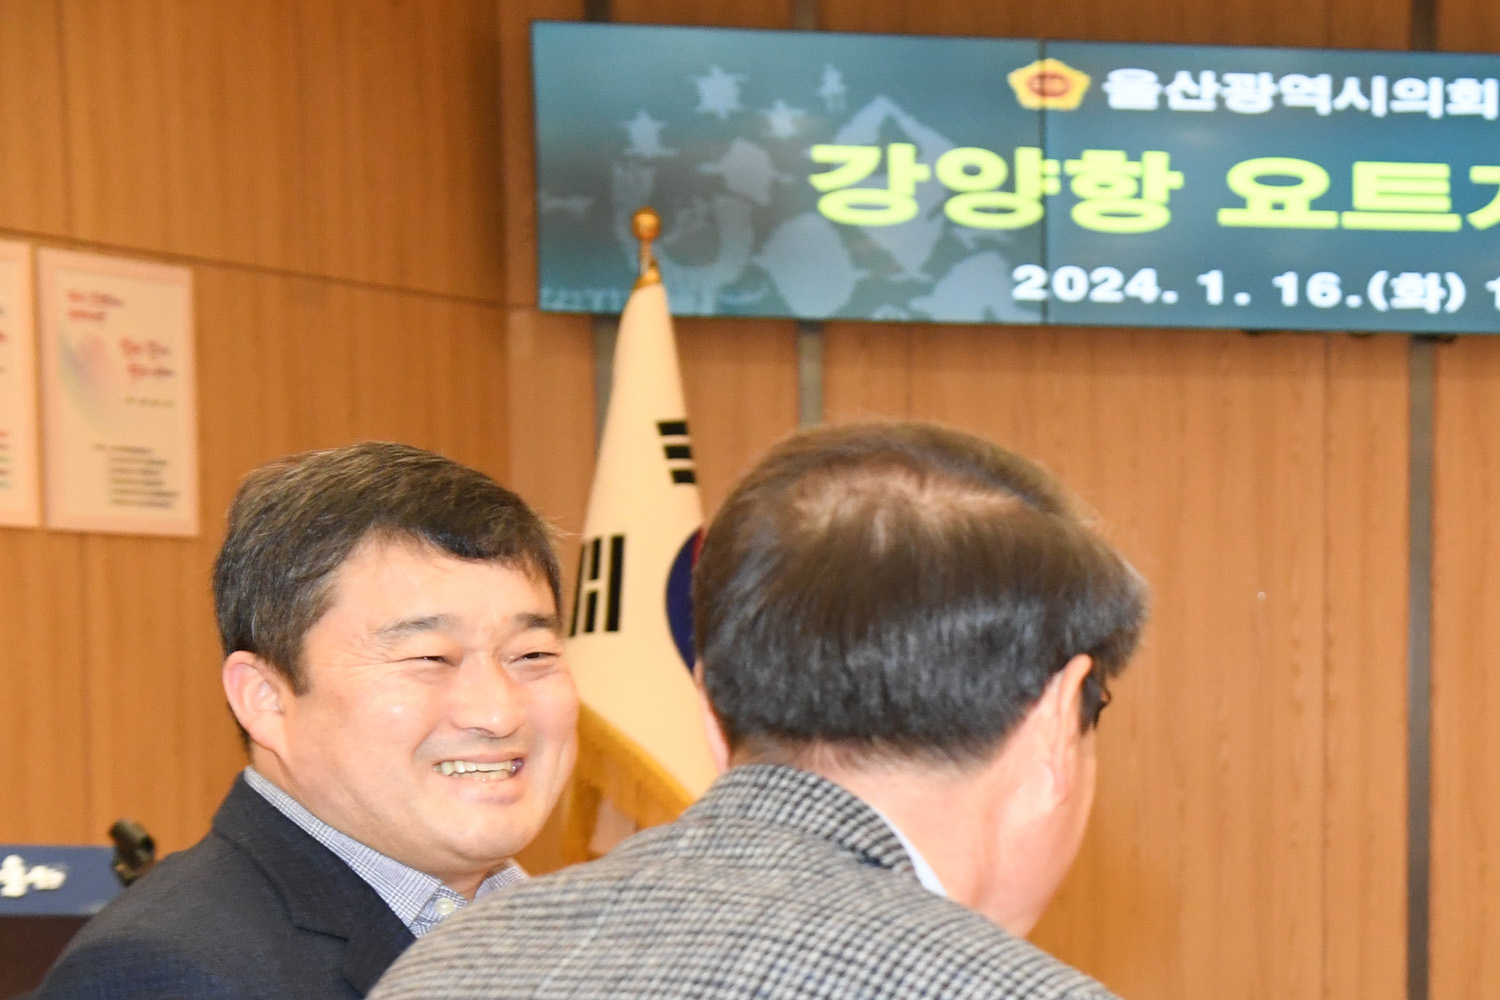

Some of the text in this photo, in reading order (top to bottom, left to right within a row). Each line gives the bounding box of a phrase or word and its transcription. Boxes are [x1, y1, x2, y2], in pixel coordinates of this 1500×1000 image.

[1103, 67, 1499, 119] 울산광역시의회
[808, 142, 1186, 234] 강양항
[1011, 263, 1179, 304] 2024.
[1197, 270, 1251, 306] 1.
[1273, 270, 1467, 314] 16.(화)
